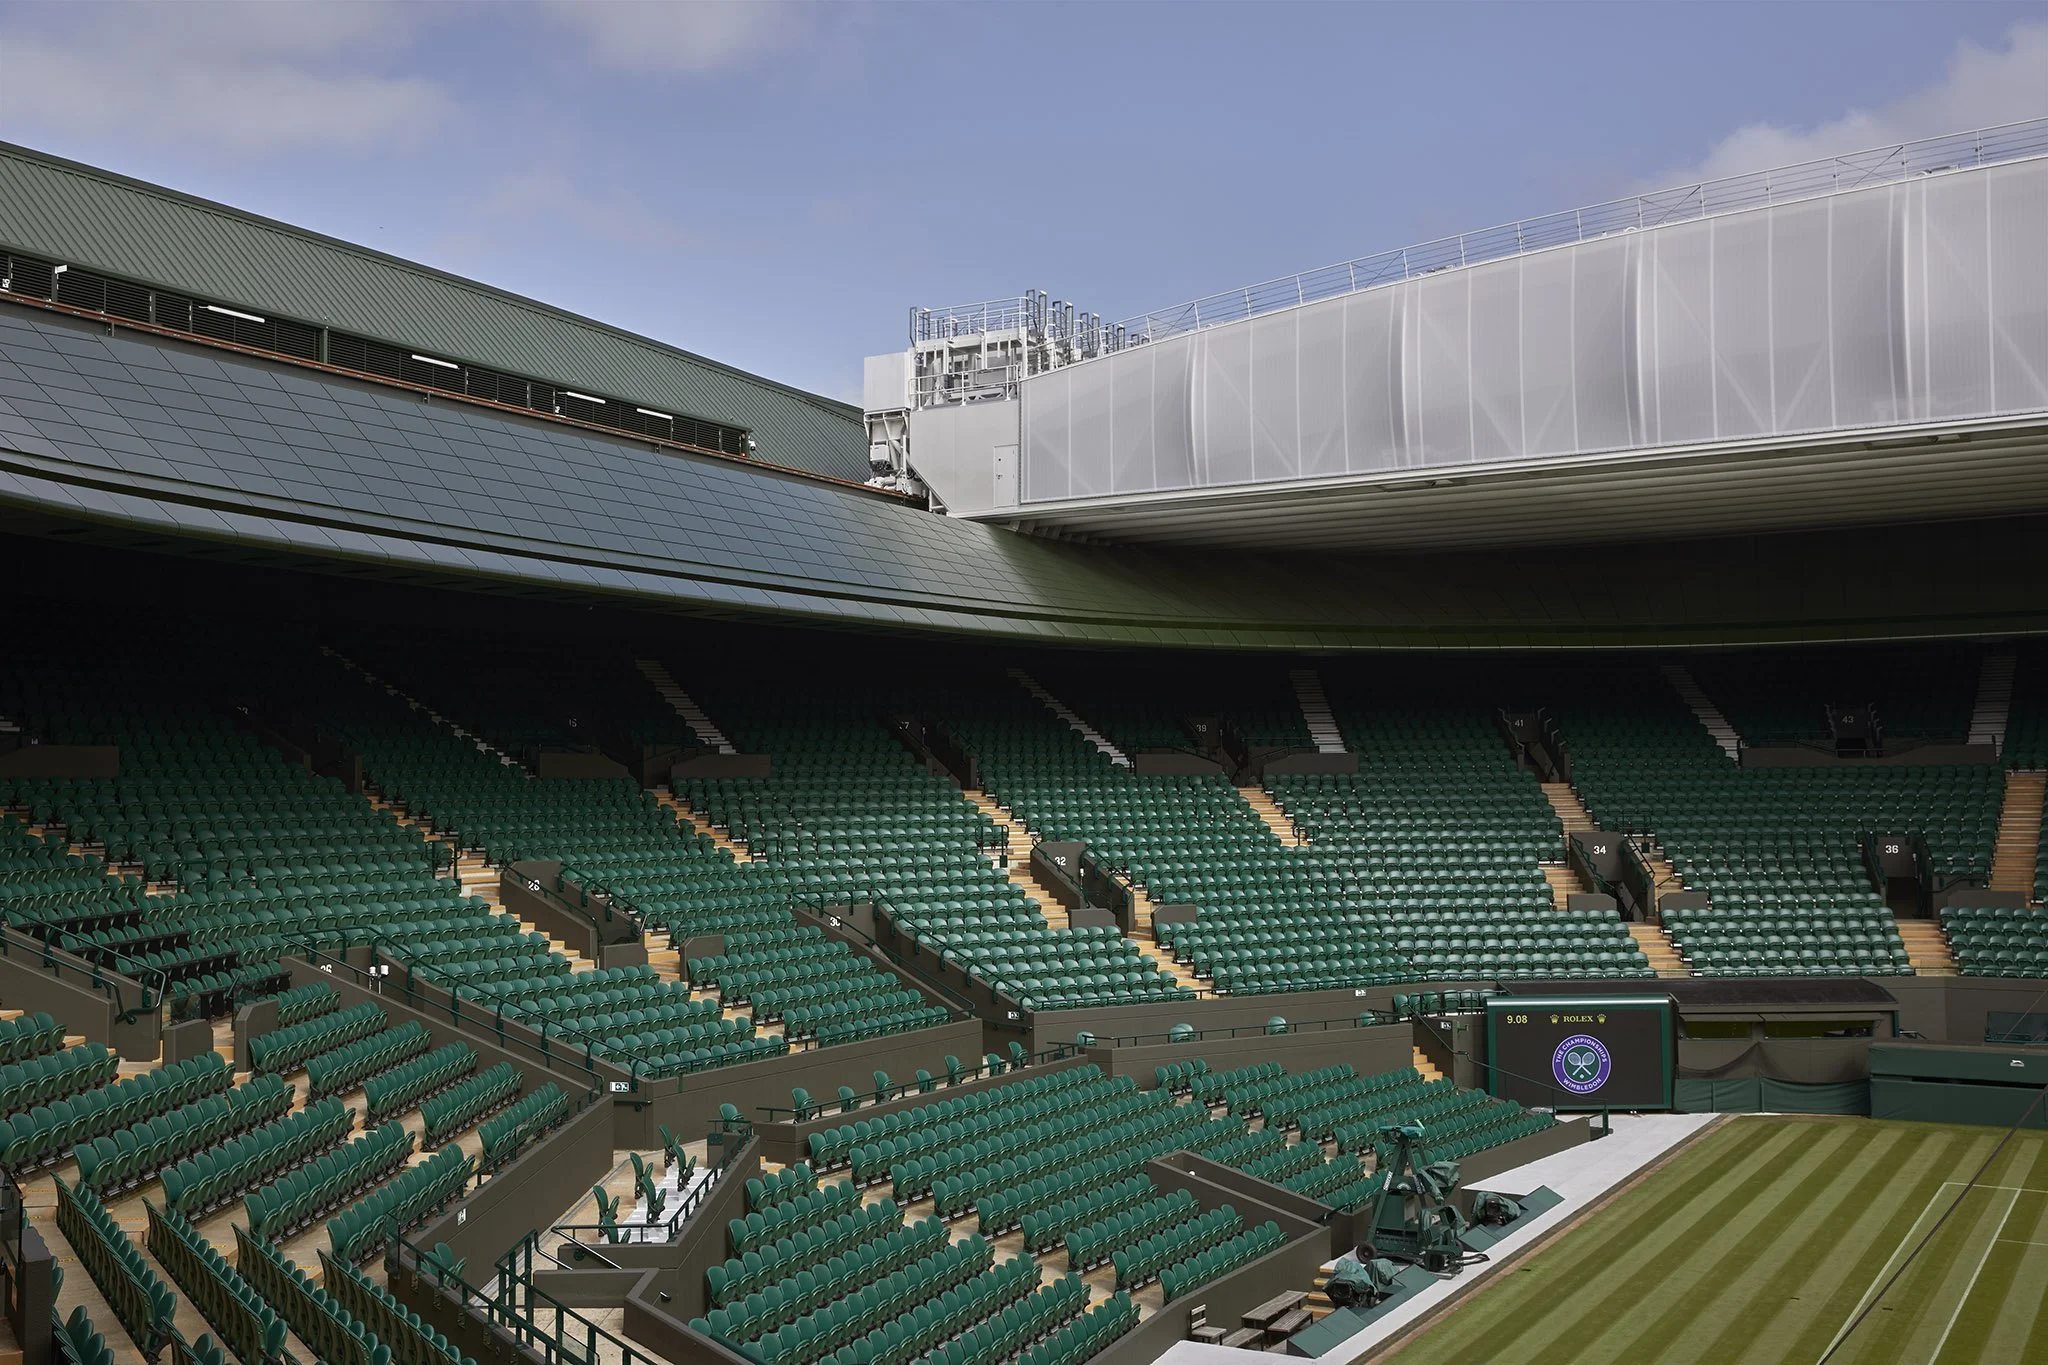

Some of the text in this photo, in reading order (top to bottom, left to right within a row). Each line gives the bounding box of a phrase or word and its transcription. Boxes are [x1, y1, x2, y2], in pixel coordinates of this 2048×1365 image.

[1514, 719, 1524, 728] 41
[1842, 715, 1854, 724] 43
[1593, 845, 1606, 855] 34
[1885, 844, 1899, 854] 36
[1054, 856, 1066, 866] 32
[1506, 1014, 1528, 1024] 9.08
[1563, 1015, 1594, 1023] ROLEX
[1555, 1037, 1608, 1063] THE CHAMPIONSHIPS
[1563, 1077, 1602, 1091] WIMBLEDON
